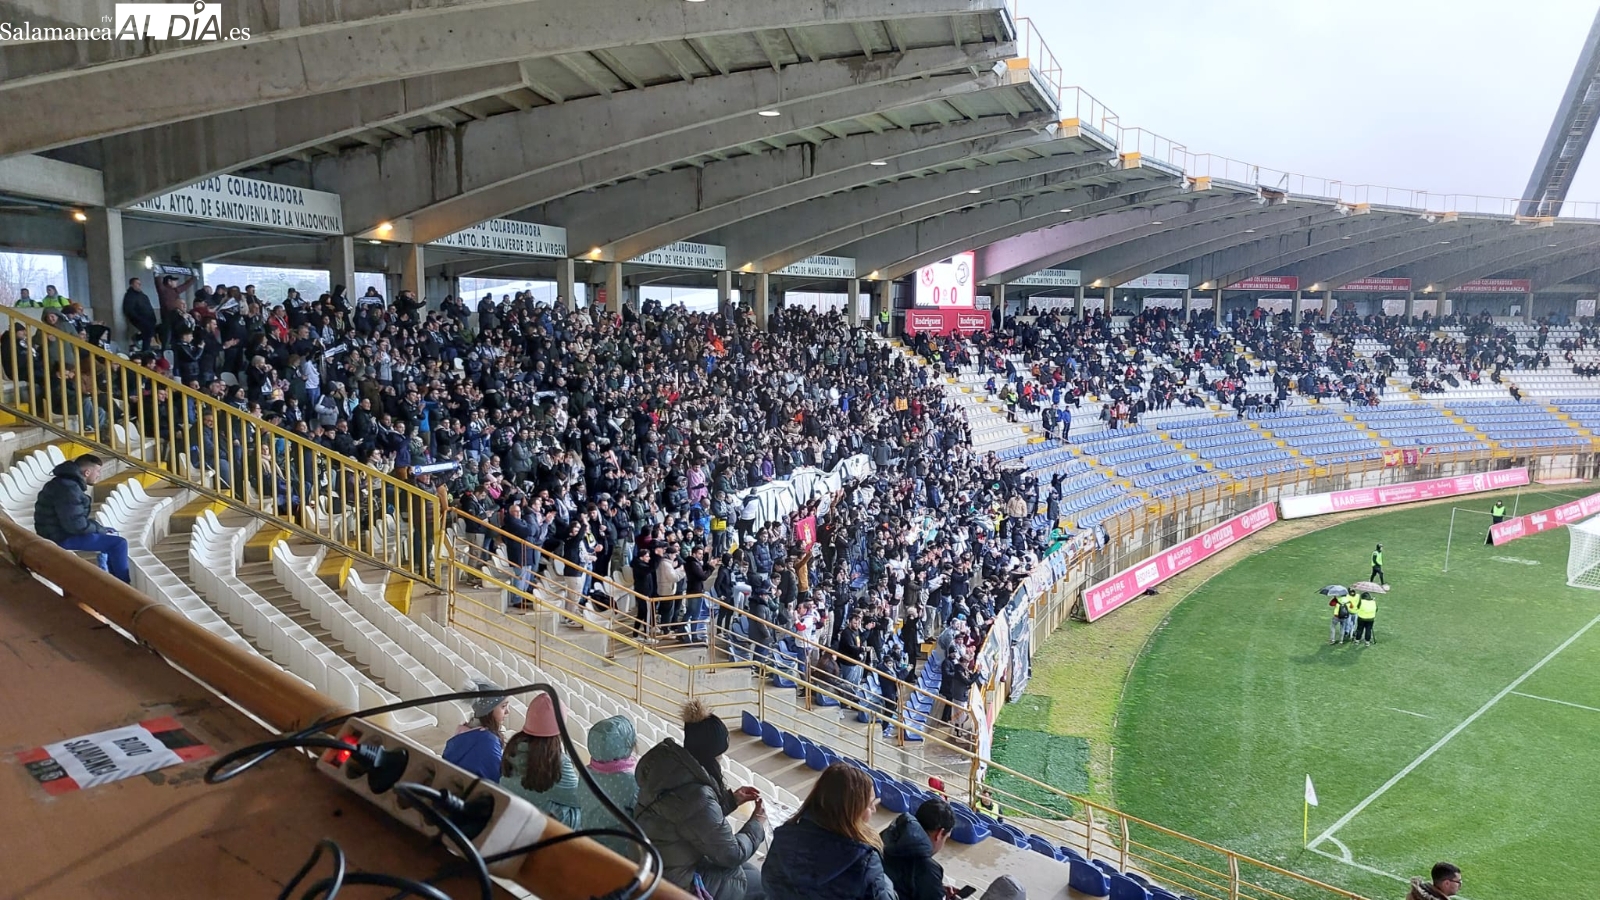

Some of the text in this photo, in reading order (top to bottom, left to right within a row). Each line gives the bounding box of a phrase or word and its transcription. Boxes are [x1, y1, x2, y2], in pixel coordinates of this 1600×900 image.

[228, 178, 304, 206] COLABORADORA
[170, 194, 198, 214] AYTO.
[201, 198, 212, 216] DE
[216, 200, 269, 224] SANTOVENIA
[272, 208, 281, 226] DE
[284, 209, 293, 226] LA
[295, 210, 340, 232] VALDONCINA
[490, 220, 542, 238] COLABORADORA
[458, 234, 479, 246] AYTO.
[482, 235, 490, 248] DE
[492, 236, 524, 251] VALVERDE
[526, 240, 533, 252] DE
[535, 241, 542, 253] LA
[544, 242, 566, 255] VIRGEN
[670, 243, 706, 254] COLABORADORA
[665, 254, 671, 264] DE
[673, 255, 686, 265] VEGA
[688, 256, 693, 266] DE
[694, 257, 723, 268] INFANZONES
[934, 286, 957, 304] 0 0
[1173, 546, 1193, 561] ASPIRE
[1101, 580, 1126, 599] ASPIRE
